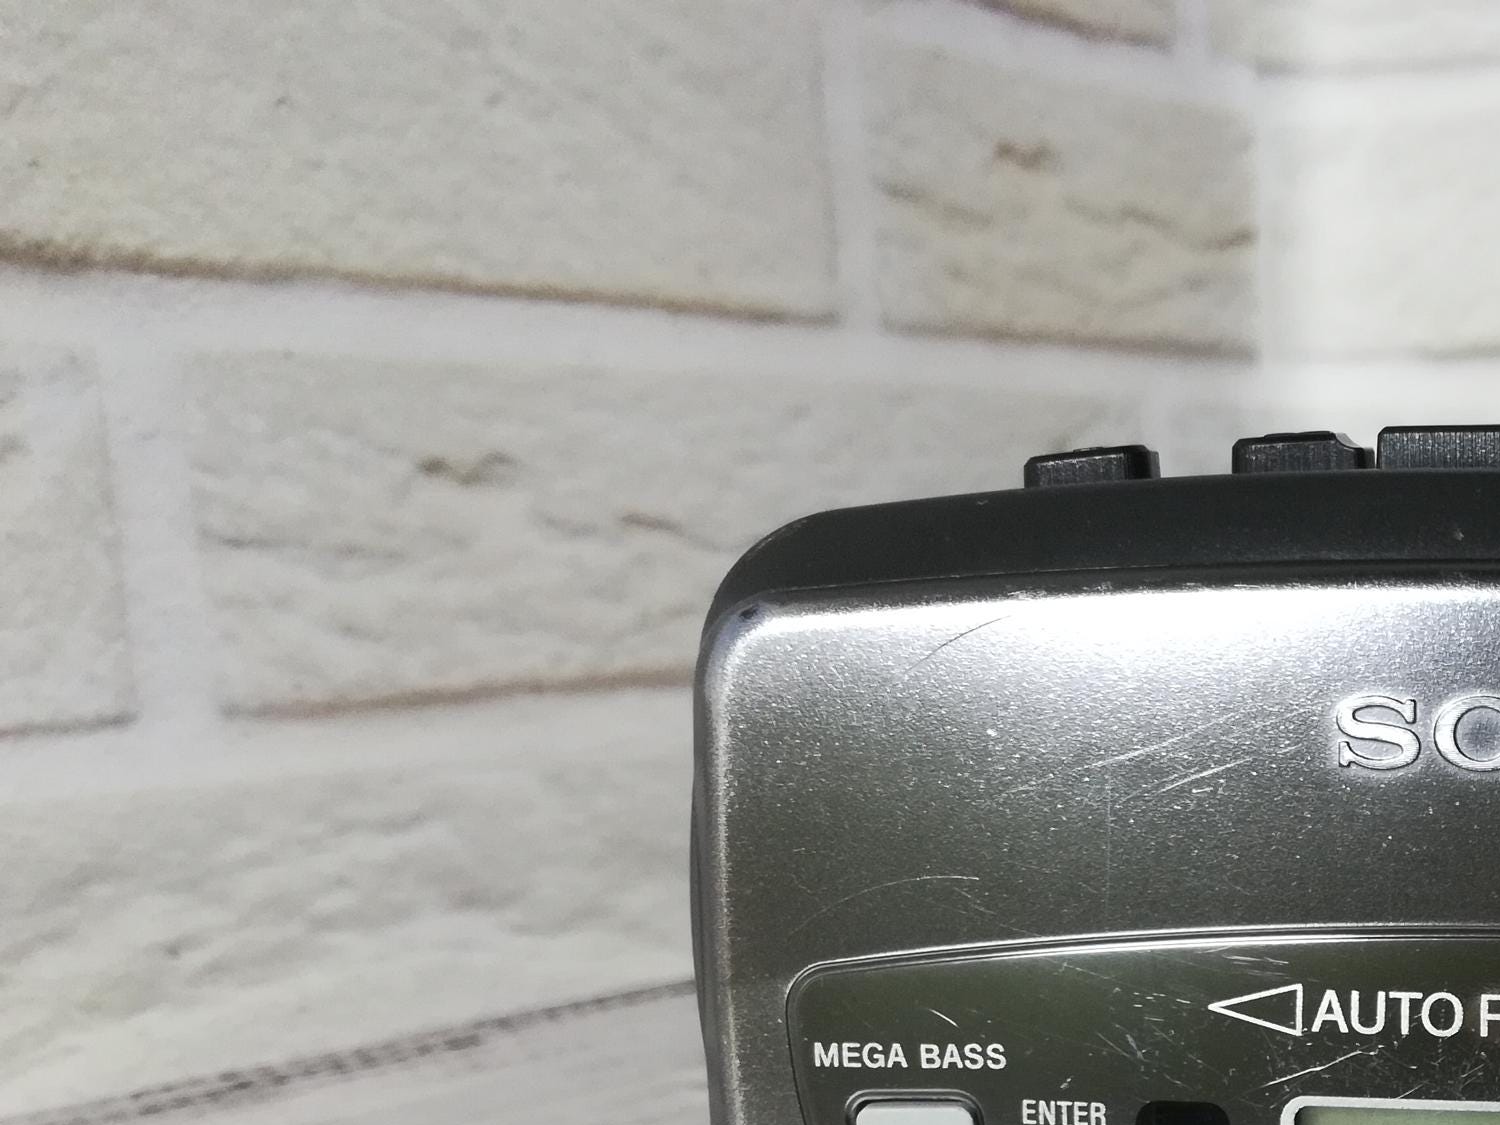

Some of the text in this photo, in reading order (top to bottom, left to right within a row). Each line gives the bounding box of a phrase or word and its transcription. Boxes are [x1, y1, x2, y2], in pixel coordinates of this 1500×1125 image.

[1311, 989, 1464, 1037] AUTO
[813, 1042, 1007, 1071] MEGA BASS
